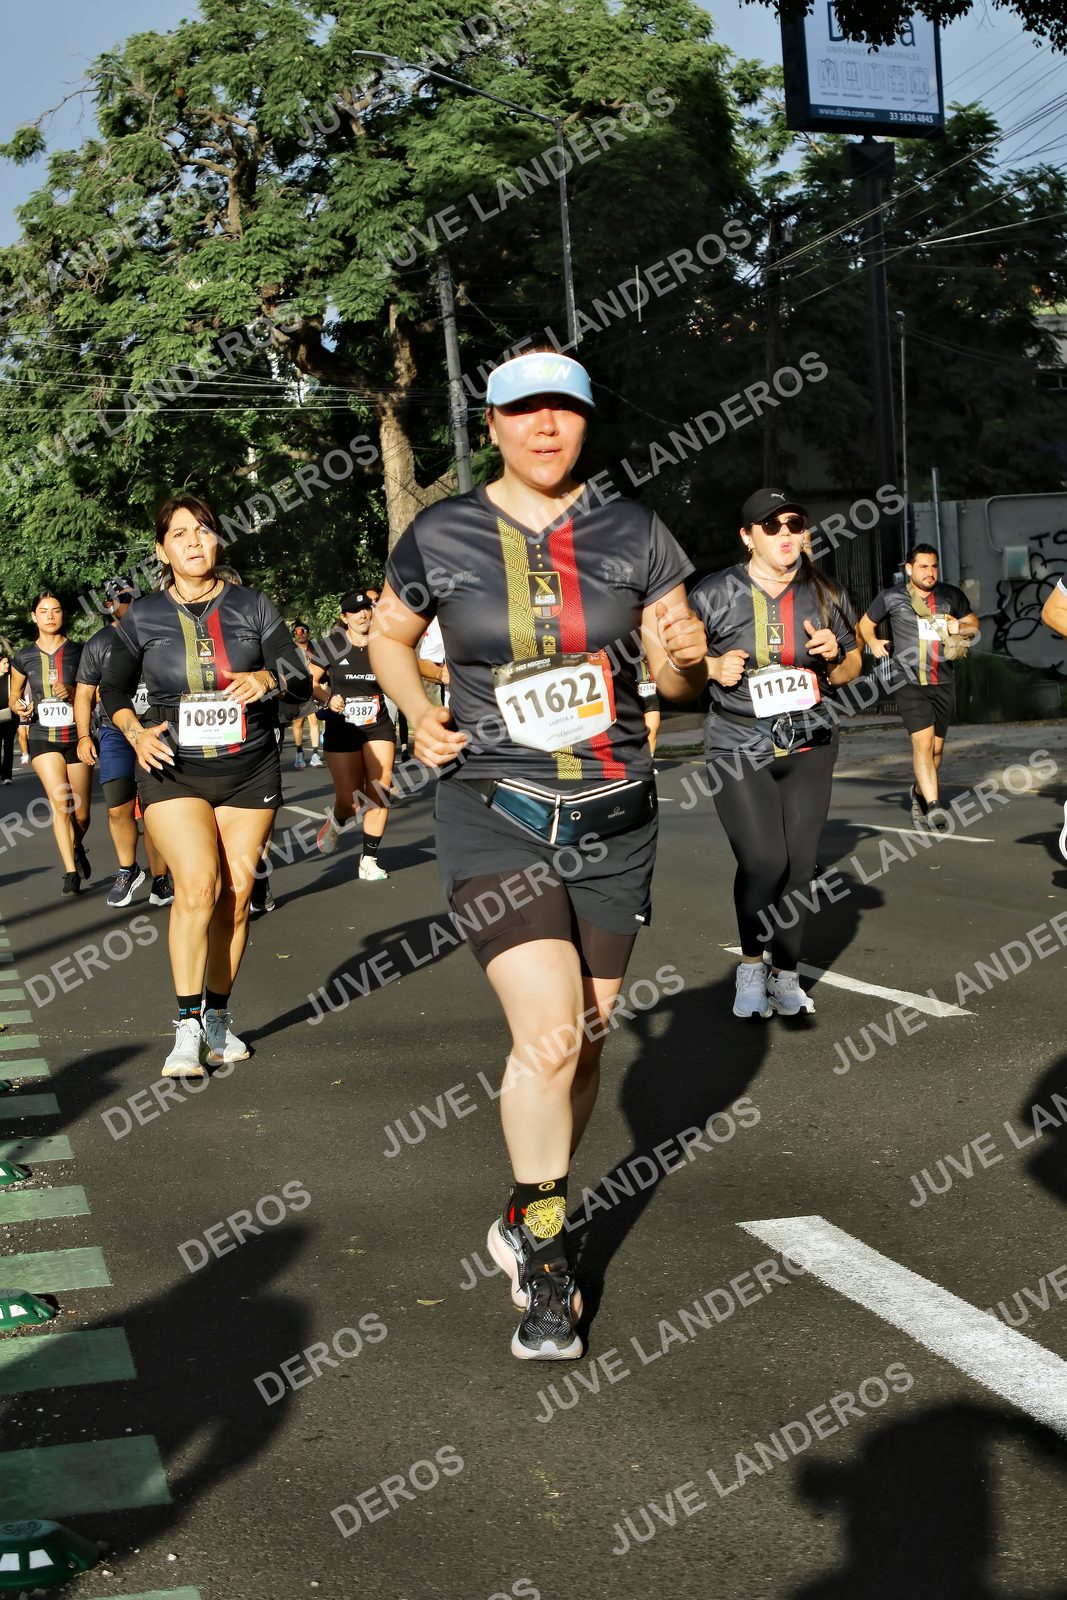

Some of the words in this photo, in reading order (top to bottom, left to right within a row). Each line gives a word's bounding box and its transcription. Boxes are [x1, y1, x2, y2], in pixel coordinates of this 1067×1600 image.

[819, 107, 876, 119] www.dibra.com.mx
[890, 112, 899, 121] 33
[899, 113, 916, 122] 3826
[916, 114, 934, 123] 4845
[754, 674, 808, 699] 11124
[506, 671, 602, 724] 11622
[43, 706, 68, 716] 9710
[184, 707, 238, 726] 10899
[350, 706, 373, 716] 9387
